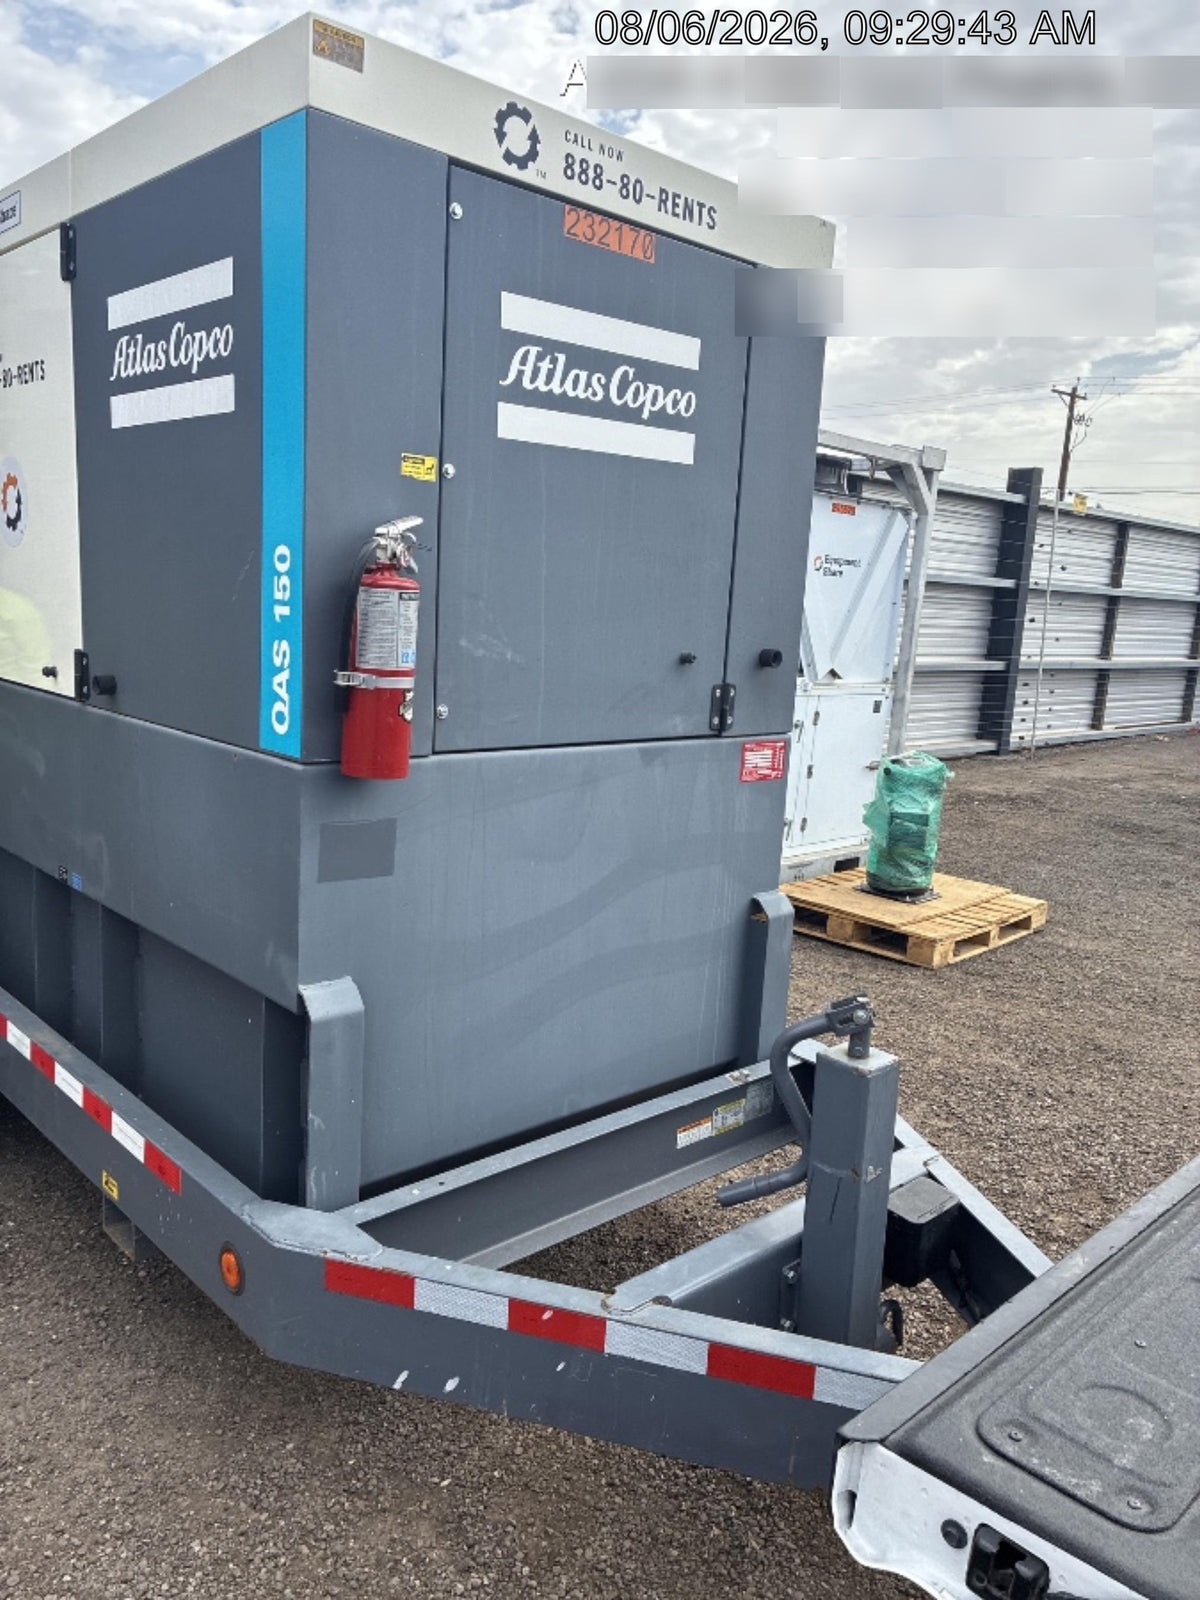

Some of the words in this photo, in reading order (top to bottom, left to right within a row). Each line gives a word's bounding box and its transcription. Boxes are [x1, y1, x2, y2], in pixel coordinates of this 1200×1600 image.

[564, 129, 593, 152] CALL
[599, 144, 625, 163] NOW
[562, 152, 718, 231] 888-80-RENTS
[565, 207, 655, 262] 232170
[0, 358, 45, 388] 80-RENTS
[109, 333, 167, 381] Atlas
[169, 321, 234, 374] Copco
[499, 345, 606, 402] Atlas
[609, 365, 697, 420] Copco
[273, 543, 292, 624] 150
[271, 639, 291, 735] QAS
